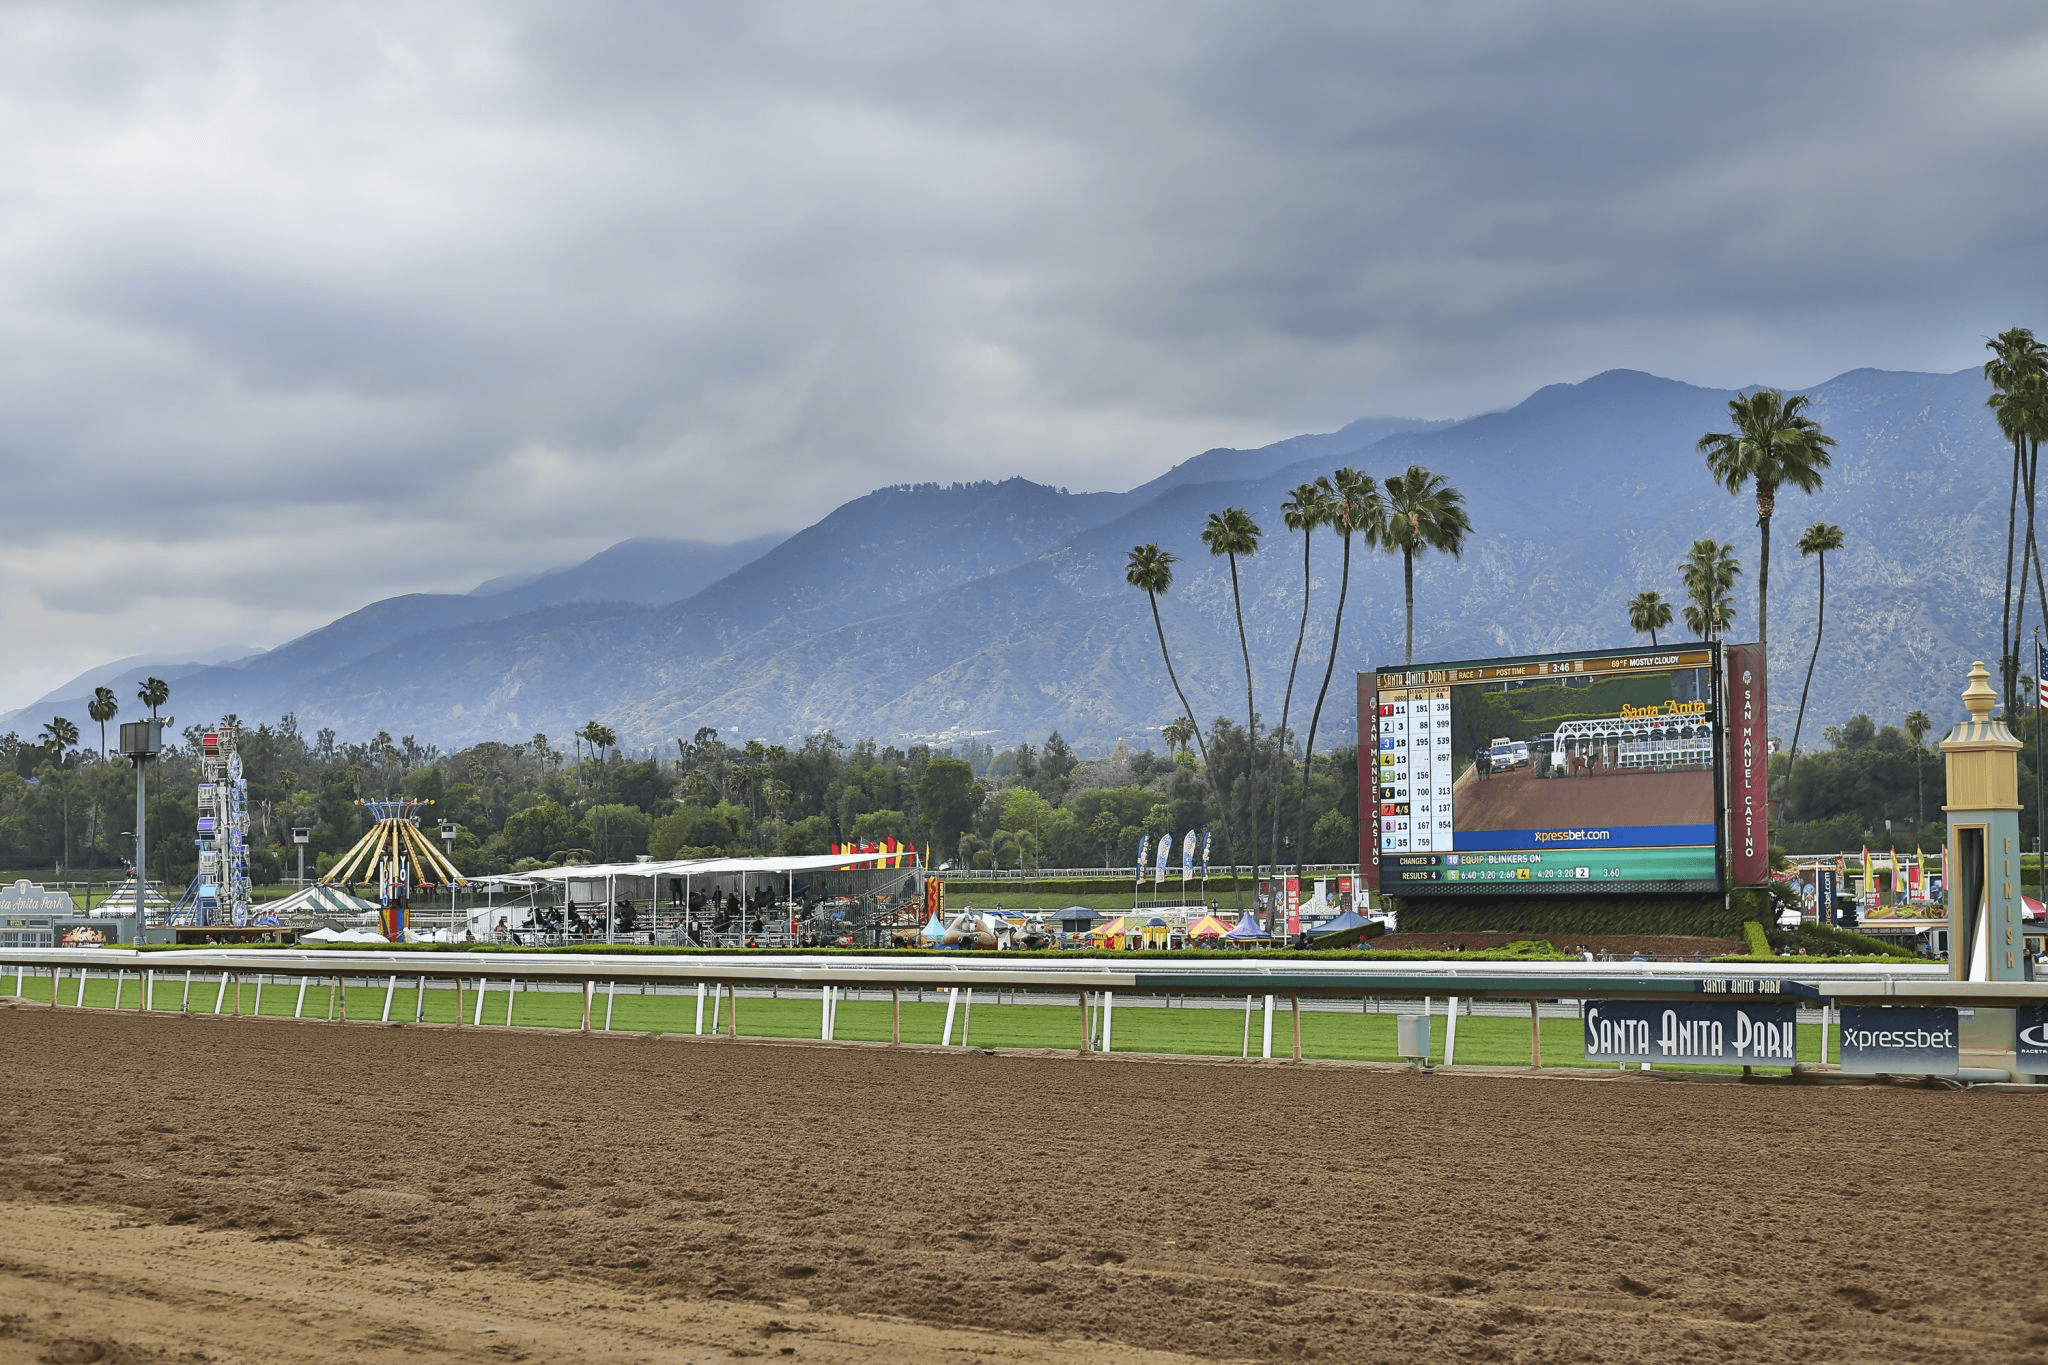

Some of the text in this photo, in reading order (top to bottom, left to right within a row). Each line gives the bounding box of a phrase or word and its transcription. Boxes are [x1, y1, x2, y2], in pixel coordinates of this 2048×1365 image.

[1611, 655, 1680, 668] 69°F MOSTLY CLOUDY
[1552, 663, 1570, 673] 3:46
[1383, 673, 1403, 688] SANTA
[1405, 671, 1425, 686] ANITA
[1458, 669, 1483, 679] RACE 7
[1396, 706, 1406, 714] 11
[1416, 705, 1428, 713] 181
[1436, 703, 1449, 711] 336
[1620, 700, 1706, 721] Santa Anita
[1370, 715, 1378, 742] SAN
[1436, 720, 1449, 728] 999
[1396, 739, 1406, 747] 18
[1416, 738, 1429, 746] 195
[1437, 737, 1450, 745] 539
[1438, 753, 1450, 761] 697
[1744, 728, 1752, 789] MANUEL
[1370, 749, 1378, 804] MANUEL
[1396, 772, 1407, 780] 10
[1397, 789, 1407, 797] 60
[1416, 788, 1429, 796] 700
[1438, 787, 1450, 795] 313
[1395, 805, 1409, 814] 4/5
[1438, 804, 1451, 812] 137
[1398, 822, 1407, 830] 13
[1745, 796, 1754, 857] CASINO
[1535, 829, 1610, 843] xpressbet.com
[1417, 838, 1430, 846] 759
[1399, 856, 1436, 865] CHANGES 9
[1449, 856, 1458, 865] 10
[1488, 854, 1528, 864] BLINKERS
[1529, 854, 1541, 863] ON
[1402, 871, 1436, 880] RESULTS 4
[1461, 871, 1477, 880] 6.40
[1480, 870, 1496, 879] 3.20
[1500, 870, 1515, 879] 2.60
[1537, 869, 1553, 878] 4.20
[1557, 869, 1574, 878] 3.20
[1603, 868, 1620, 877] 3.60
[13, 897, 39, 911] Anita
[40, 897, 64, 910] Park
[1824, 872, 1832, 926] pressbet.com
[2004, 836, 2014, 969] FINISH
[1703, 979, 1781, 994] SANTA ANITA PARK
[1587, 1007, 1793, 1058] SANTA ANITA PARK
